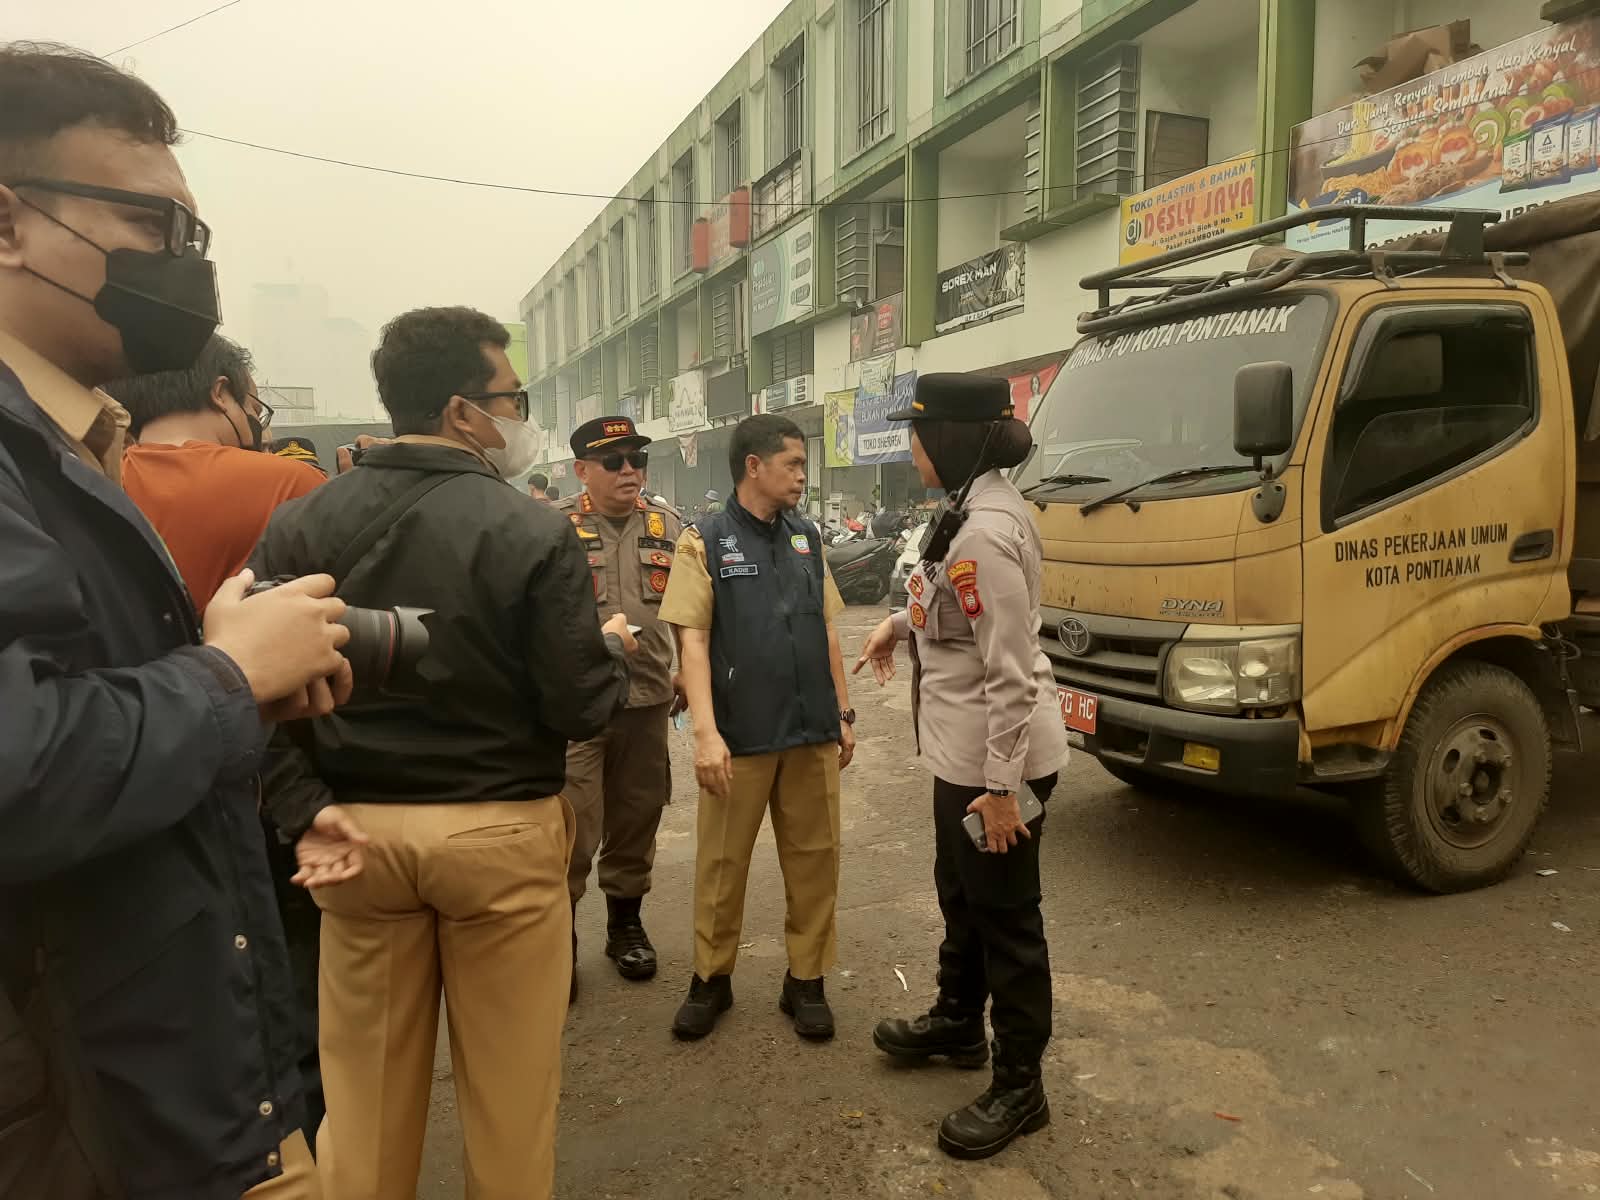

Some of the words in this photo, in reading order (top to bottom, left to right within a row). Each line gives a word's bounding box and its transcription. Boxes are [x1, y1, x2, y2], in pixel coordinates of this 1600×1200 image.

[1496, 53, 1522, 72] dan
[1527, 34, 1577, 62] Kenyal
[1129, 197, 1153, 214] TOKO
[1156, 181, 1195, 207] PLASTIK
[1199, 178, 1206, 189] &
[1209, 165, 1247, 186] BAHAN
[1143, 194, 1197, 240] DESLY
[1203, 176, 1254, 219] JAYA
[1160, 233, 1177, 244] Gajah
[1178, 227, 1195, 237] Mada
[1197, 221, 1211, 232] Blok
[1220, 216, 1232, 225] No.
[1235, 211, 1244, 221] 12
[1165, 241, 1183, 251] Pasar
[1184, 227, 1226, 246] FLAMBOYAN
[941, 270, 974, 293] SOREX
[974, 261, 997, 281] MAN
[1070, 339, 1111, 369] DINAS
[1108, 332, 1136, 359] PU
[1130, 322, 1177, 353] KOTA
[1174, 305, 1297, 345] PONTIANAK
[1335, 538, 1378, 562] DINAS
[1384, 528, 1466, 557] PEKERJAAN
[1471, 523, 1508, 545] UMUM
[1365, 565, 1400, 588] KOTA
[1406, 554, 1481, 583] PONTIANAK
[1161, 598, 1224, 612] DYNA
[1078, 695, 1095, 720] HC
